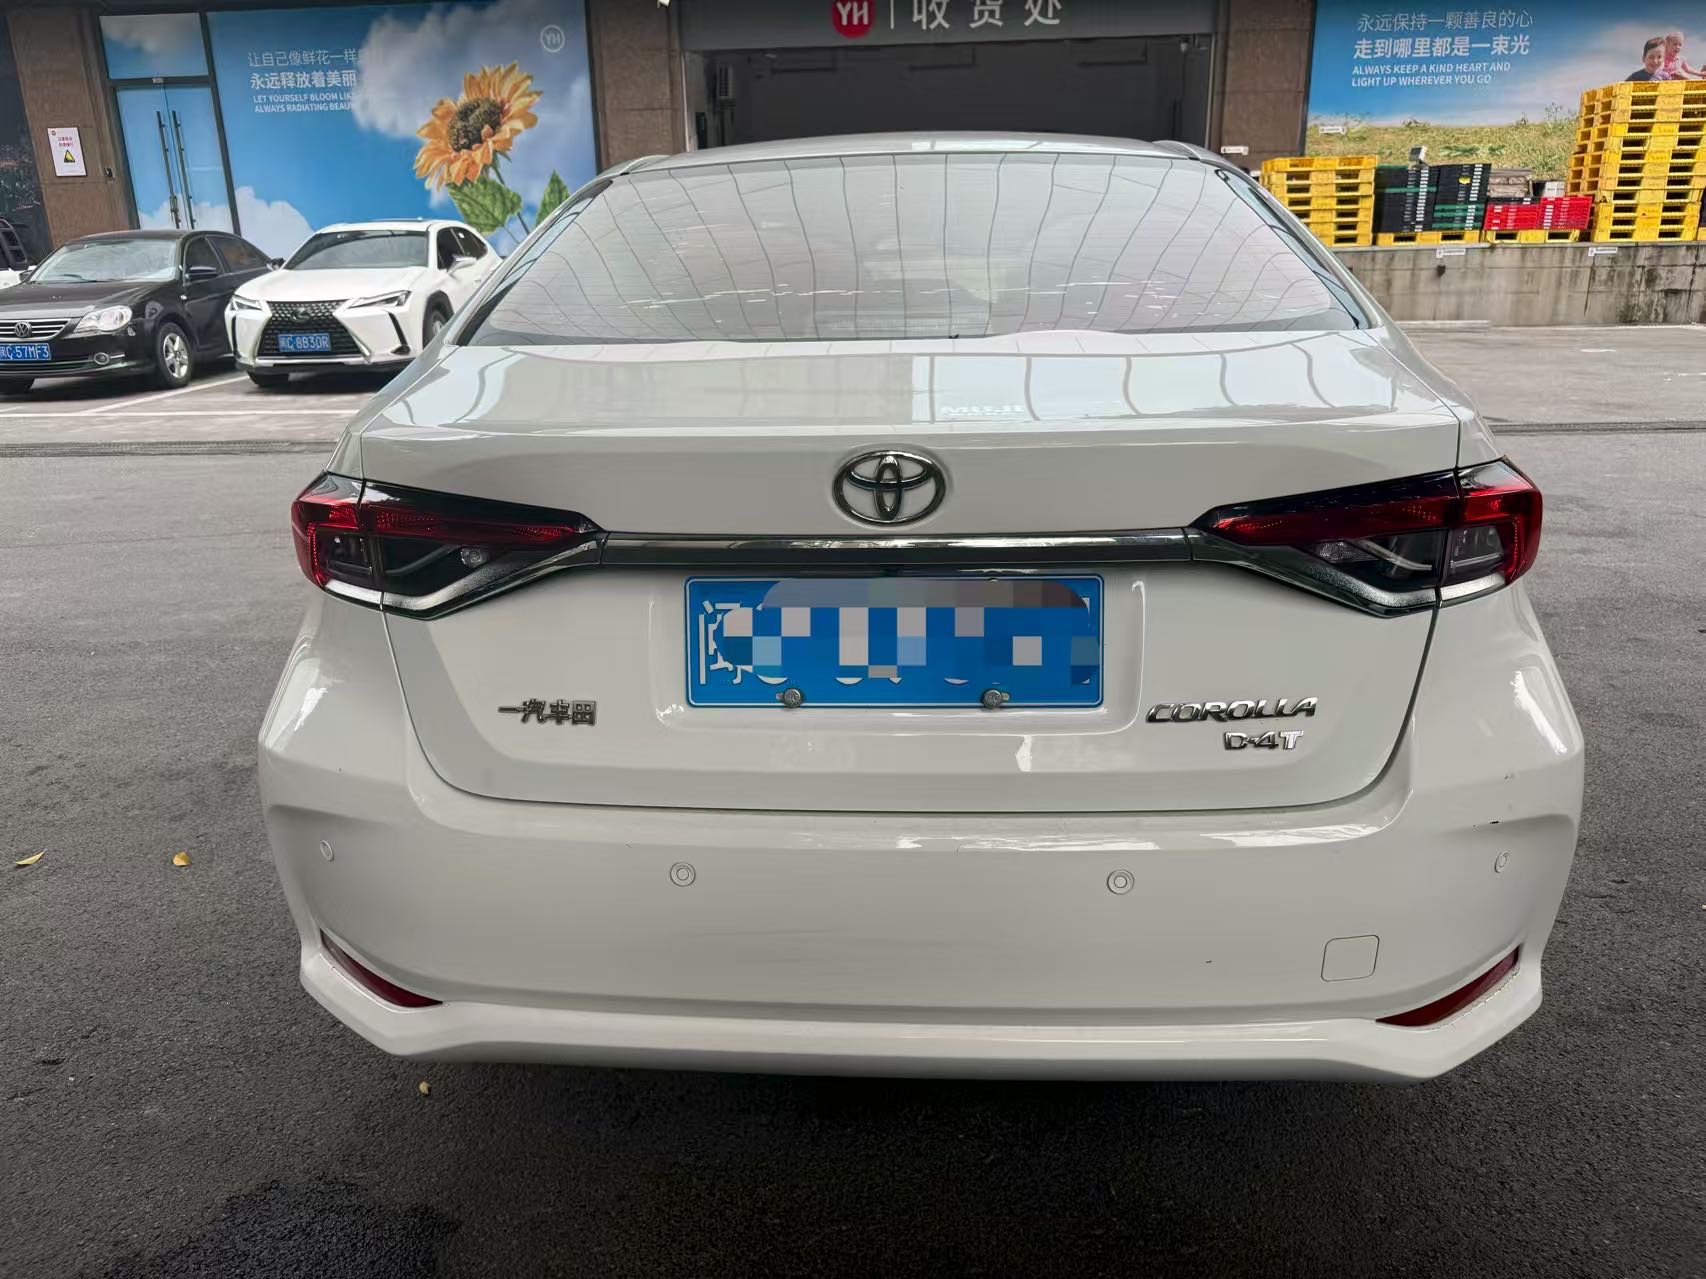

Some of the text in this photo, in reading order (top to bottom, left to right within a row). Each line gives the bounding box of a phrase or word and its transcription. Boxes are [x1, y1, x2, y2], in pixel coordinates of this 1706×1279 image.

[836, 0, 869, 26] YH
[1357, 10, 1534, 32] 永远保持一颗善良的心
[1353, 33, 1530, 59] 走到哪里都是一束光
[1352, 61, 1511, 75] ALWAYS KEEP A KIND HEART AND
[250, 70, 357, 89] 永远释放着美丽
[1352, 74, 1492, 87] LIGHT UP WHEREVER YOU GO
[253, 95, 268, 103] LET
[268, 93, 309, 103] YOURSELF
[309, 92, 338, 102] BLOOM
[254, 104, 286, 113] ALWAYS
[286, 102, 329, 112] RADIATING
[1145, 697, 1318, 723] COROLLA
